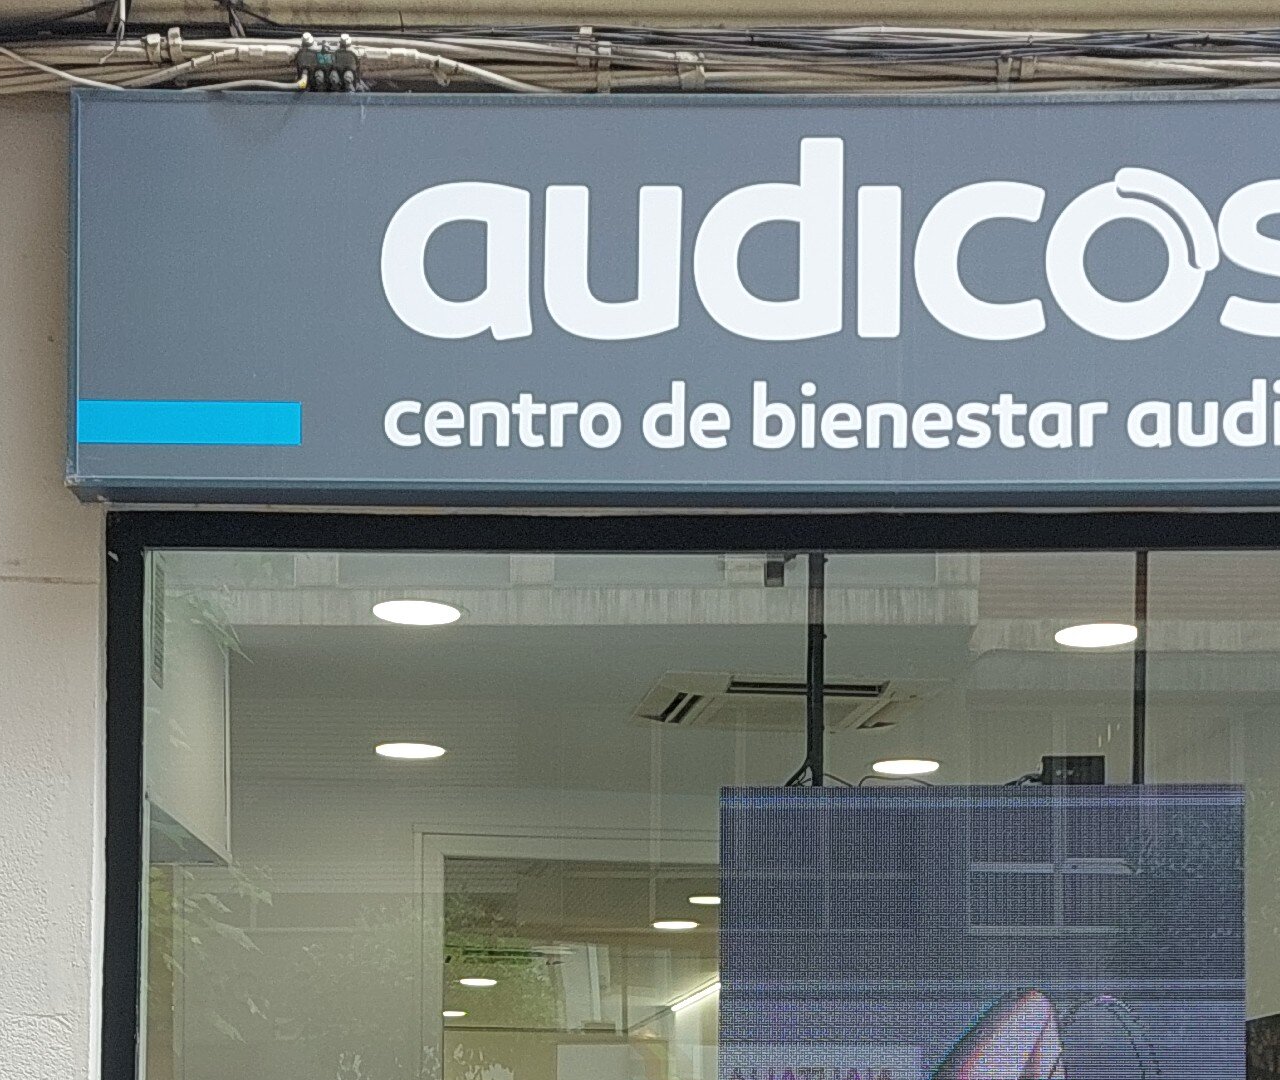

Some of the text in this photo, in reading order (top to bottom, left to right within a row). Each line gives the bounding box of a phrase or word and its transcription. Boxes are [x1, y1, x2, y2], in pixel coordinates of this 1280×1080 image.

[383, 393, 621, 450] centro
[642, 380, 731, 450] de
[752, 380, 1110, 450] bienestar
